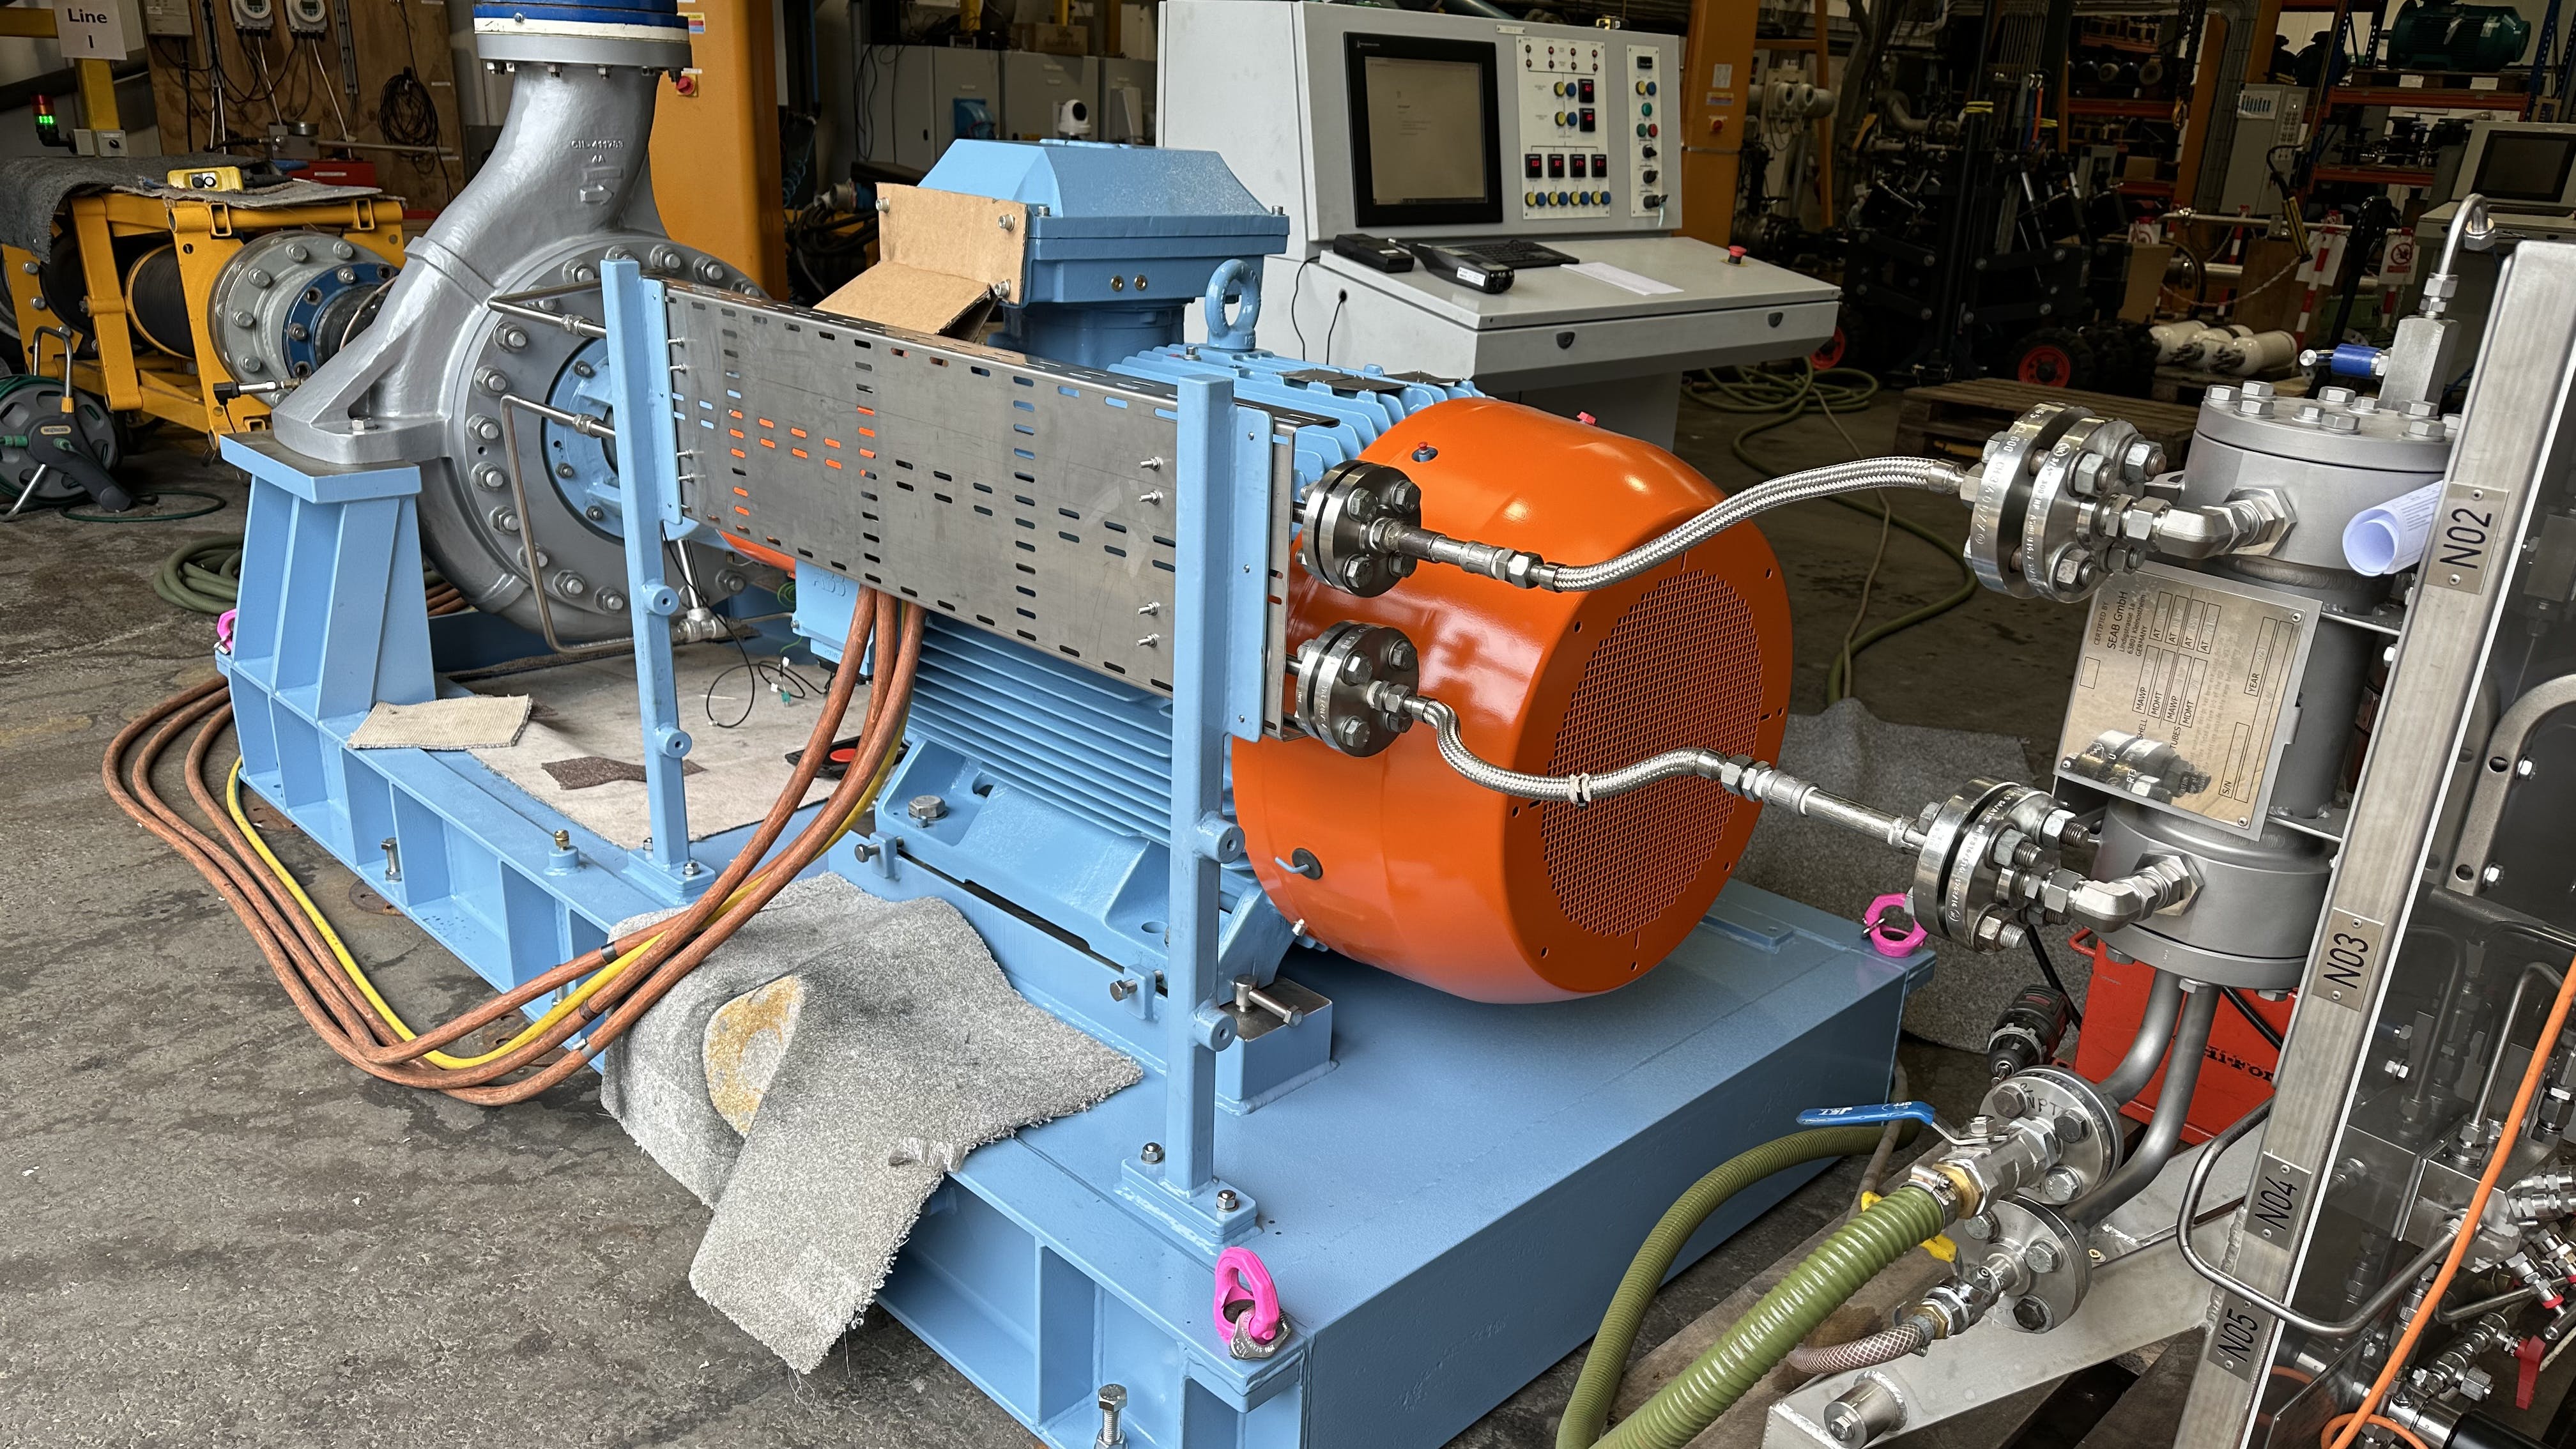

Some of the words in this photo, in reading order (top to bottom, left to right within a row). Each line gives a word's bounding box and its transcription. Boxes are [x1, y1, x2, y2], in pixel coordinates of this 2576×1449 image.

[67, 8, 108, 24] Line
[2113, 590, 2128, 622] GmbH
[2094, 611, 2106, 645] CERTIFIED
[2103, 601, 2109, 611] BY
[2119, 612, 2133, 652] Lindigstrasse
[2127, 635, 2137, 654] 63801
[2132, 594, 2147, 634] Kleinostheim
[2152, 628, 2162, 639] AT
[2107, 624, 2120, 649] SEAB
[2135, 625, 2147, 657] GERMANY
[2168, 632, 2178, 643] AT
[2184, 636, 2193, 647] AT
[2200, 640, 2210, 652] AT
[2248, 673, 2260, 693] YEAR
[2135, 686, 2148, 711] MAWP
[2150, 691, 2164, 715] MDMT
[2166, 694, 2179, 720] MAWP
[2182, 700, 2195, 724] MDMT
[2136, 717, 2149, 740] SHELL
[2169, 725, 2182, 750] TUBES
[2223, 779, 2233, 795] S/N
[1816, 1106, 1853, 1116] JET
